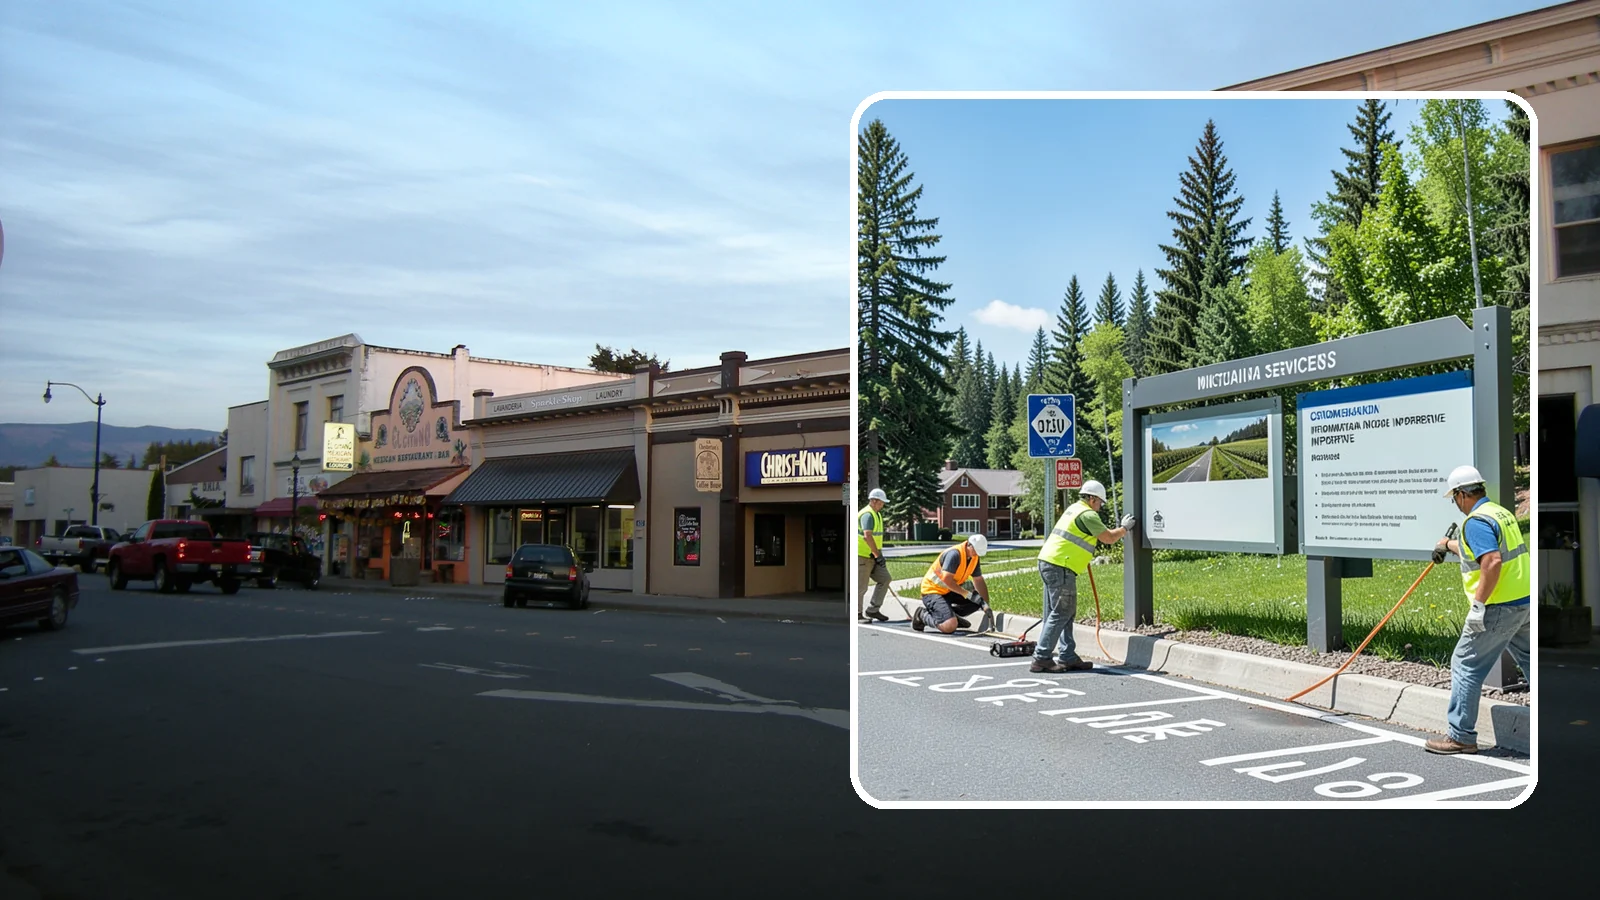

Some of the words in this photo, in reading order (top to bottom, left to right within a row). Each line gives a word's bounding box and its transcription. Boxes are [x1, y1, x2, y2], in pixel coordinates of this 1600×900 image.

[493, 402, 523, 413] LAVANDERIA
[562, 394, 582, 405] Shop
[595, 389, 624, 400] LAUNDRY
[373, 455, 396, 464] MEXICAN
[397, 451, 434, 462] RESTAURANT
[438, 450, 450, 459] BAR
[760, 452, 797, 478] CHRIST
[799, 450, 827, 476] KING
